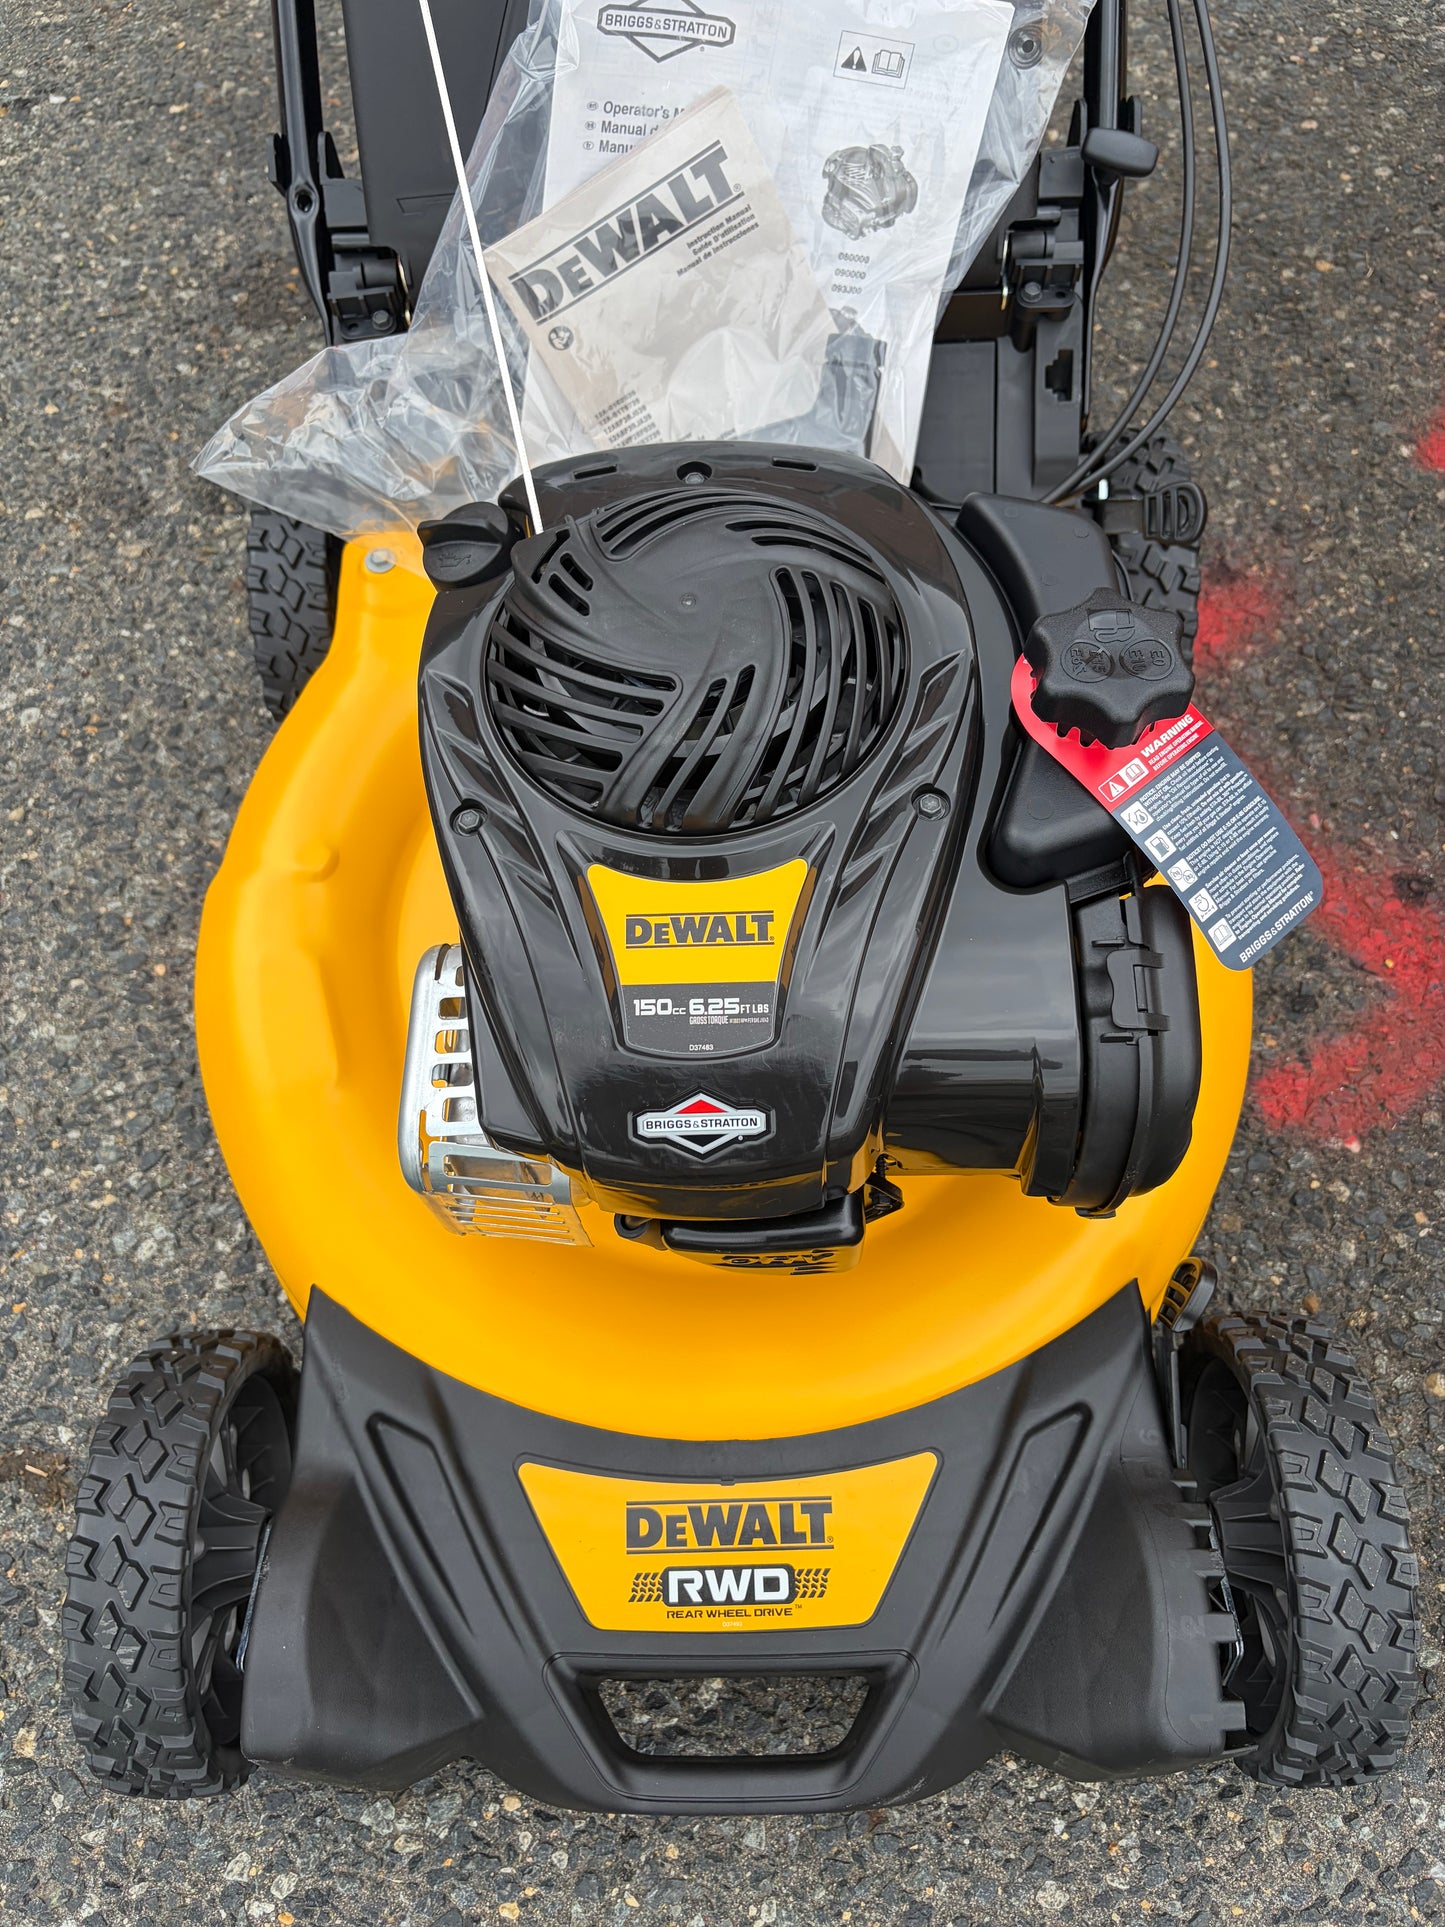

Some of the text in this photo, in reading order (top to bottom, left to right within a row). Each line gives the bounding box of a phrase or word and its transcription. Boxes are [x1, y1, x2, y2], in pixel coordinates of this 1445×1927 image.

[605, 13, 727, 38] BRIGGS&STRATTON
[603, 101, 670, 119] Operator's
[601, 120, 647, 136] Manual
[686, 204, 752, 249] Instruction Manual
[692, 213, 756, 255] Guide D'utilisation
[677, 256, 703, 277] Manual
[703, 251, 712, 260] de
[1140, 713, 1194, 758] WARNING
[1238, 892, 1314, 963] BRIGGS&STRATTON
[633, 998, 686, 1016] 150cc
[752, 1003, 769, 1014] LBS
[689, 1016, 707, 1025] GROSS
[707, 1015, 729, 1025] TORQUE
[646, 1117, 757, 1130] BRIGGS&STRATTON
[668, 1567, 789, 1603] RWD
[667, 1608, 793, 1619] REAR WHEEL DRIVE
